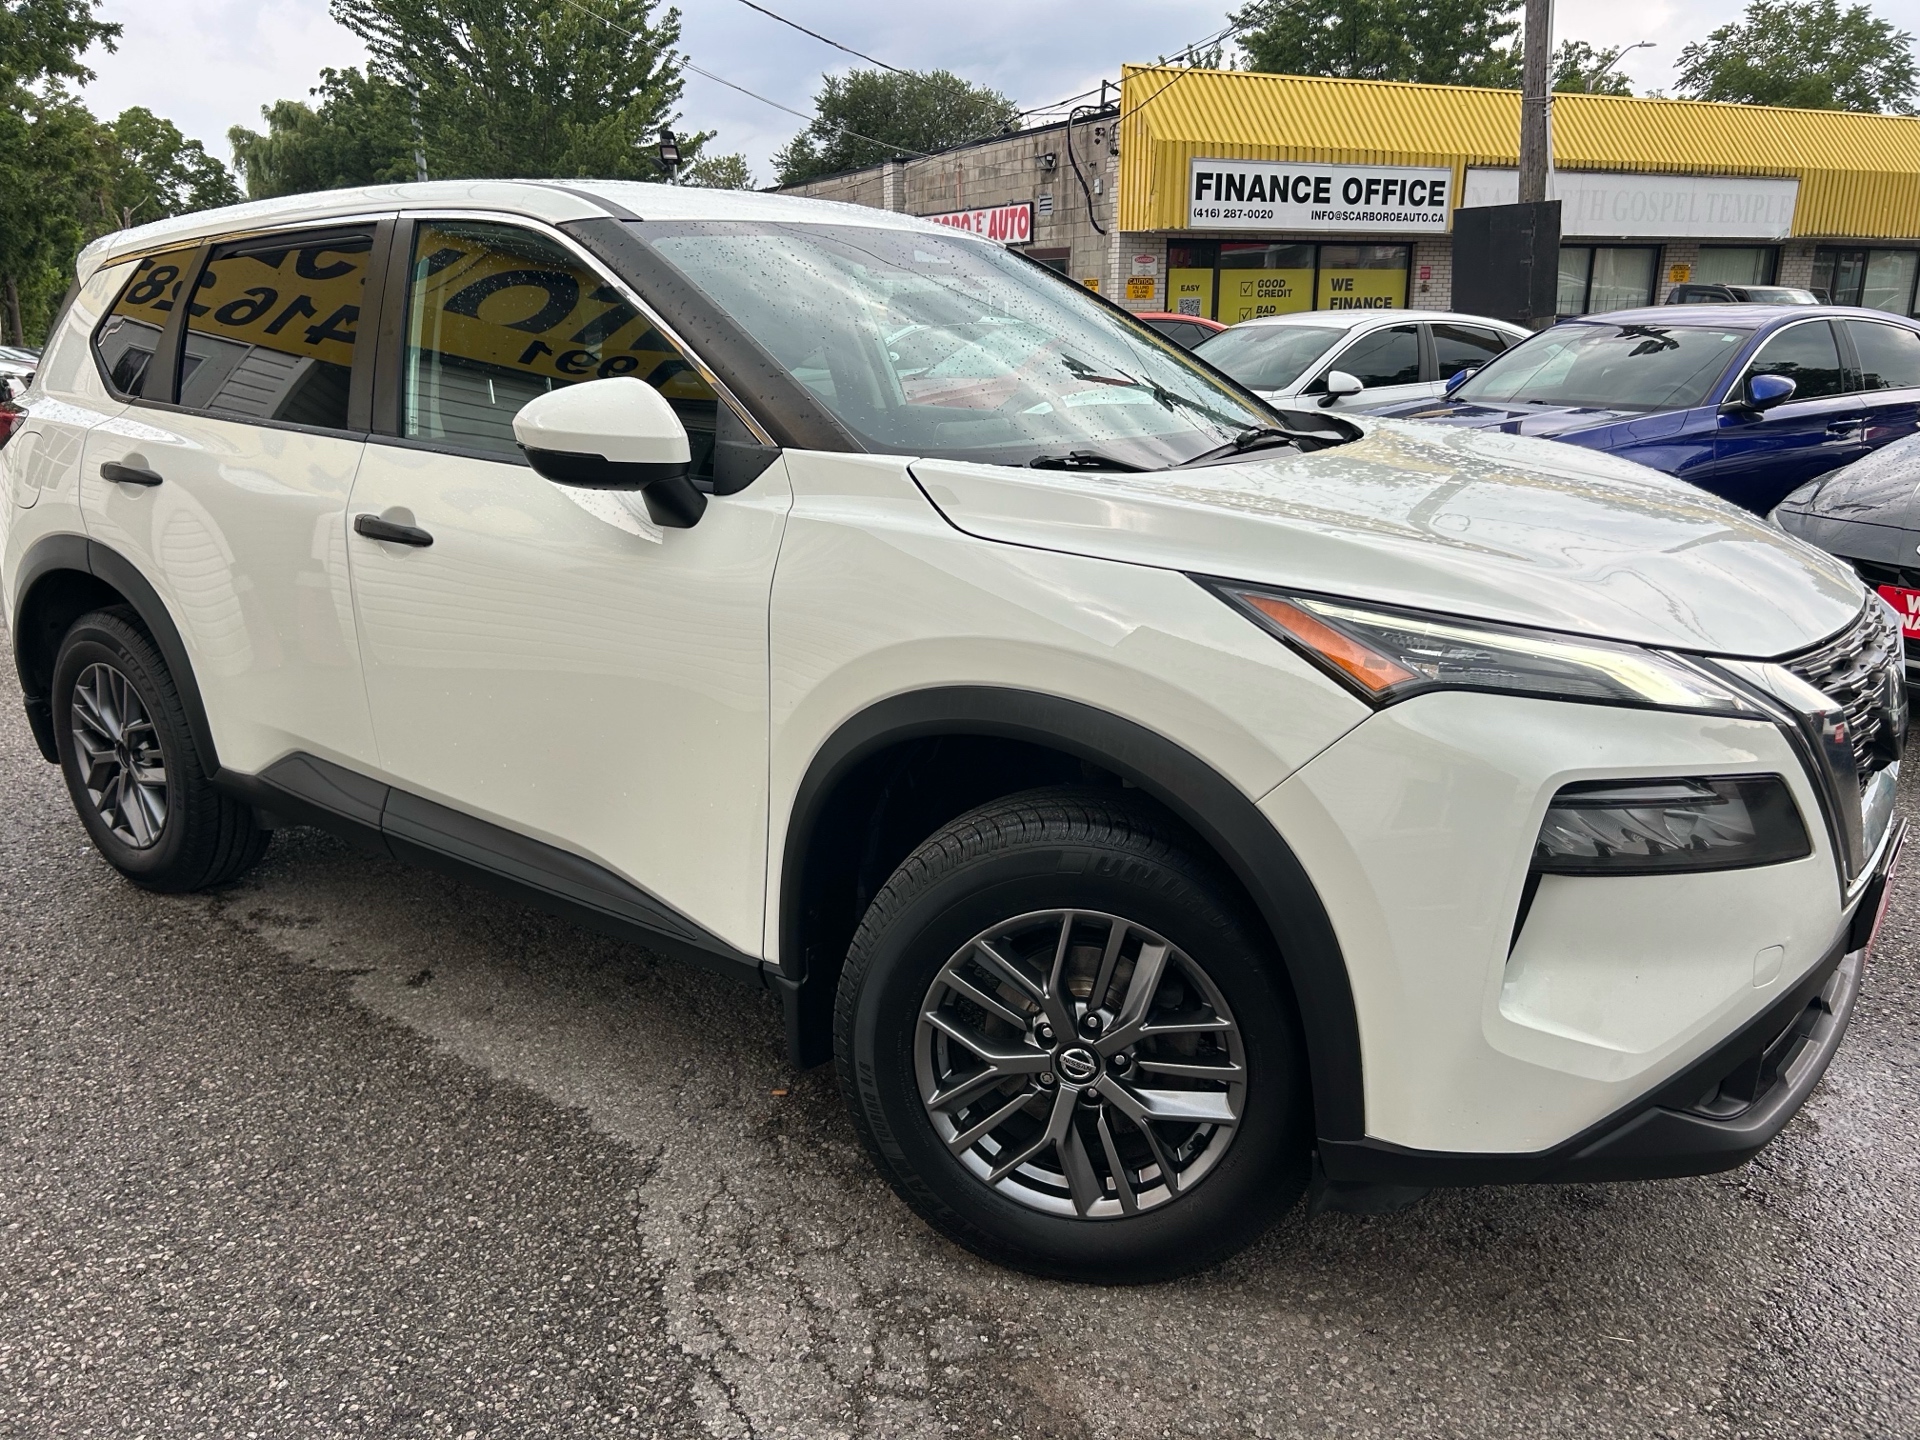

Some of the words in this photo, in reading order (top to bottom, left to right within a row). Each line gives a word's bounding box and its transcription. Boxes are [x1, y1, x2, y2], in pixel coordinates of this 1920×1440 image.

[1195, 172, 1332, 204] FINANCE
[1342, 177, 1446, 207] OFFICE
[1193, 208, 1220, 218] (416)
[1223, 209, 1274, 219] 287-0020
[1612, 190, 1700, 223] GOSPEL
[1707, 193, 1793, 225] TEMPLE
[988, 206, 1029, 240] AUTO
[1311, 211, 1444, 223] INFO@SCARBOROEAUTO.CA
[1257, 279, 1286, 289] GOOD
[1330, 278, 1354, 292] WE
[1257, 288, 1293, 298] CREDIT
[1256, 305, 1276, 314] BAD
[1329, 296, 1393, 310] FINANCE
[1063, 1057, 1091, 1071] NISSAN
